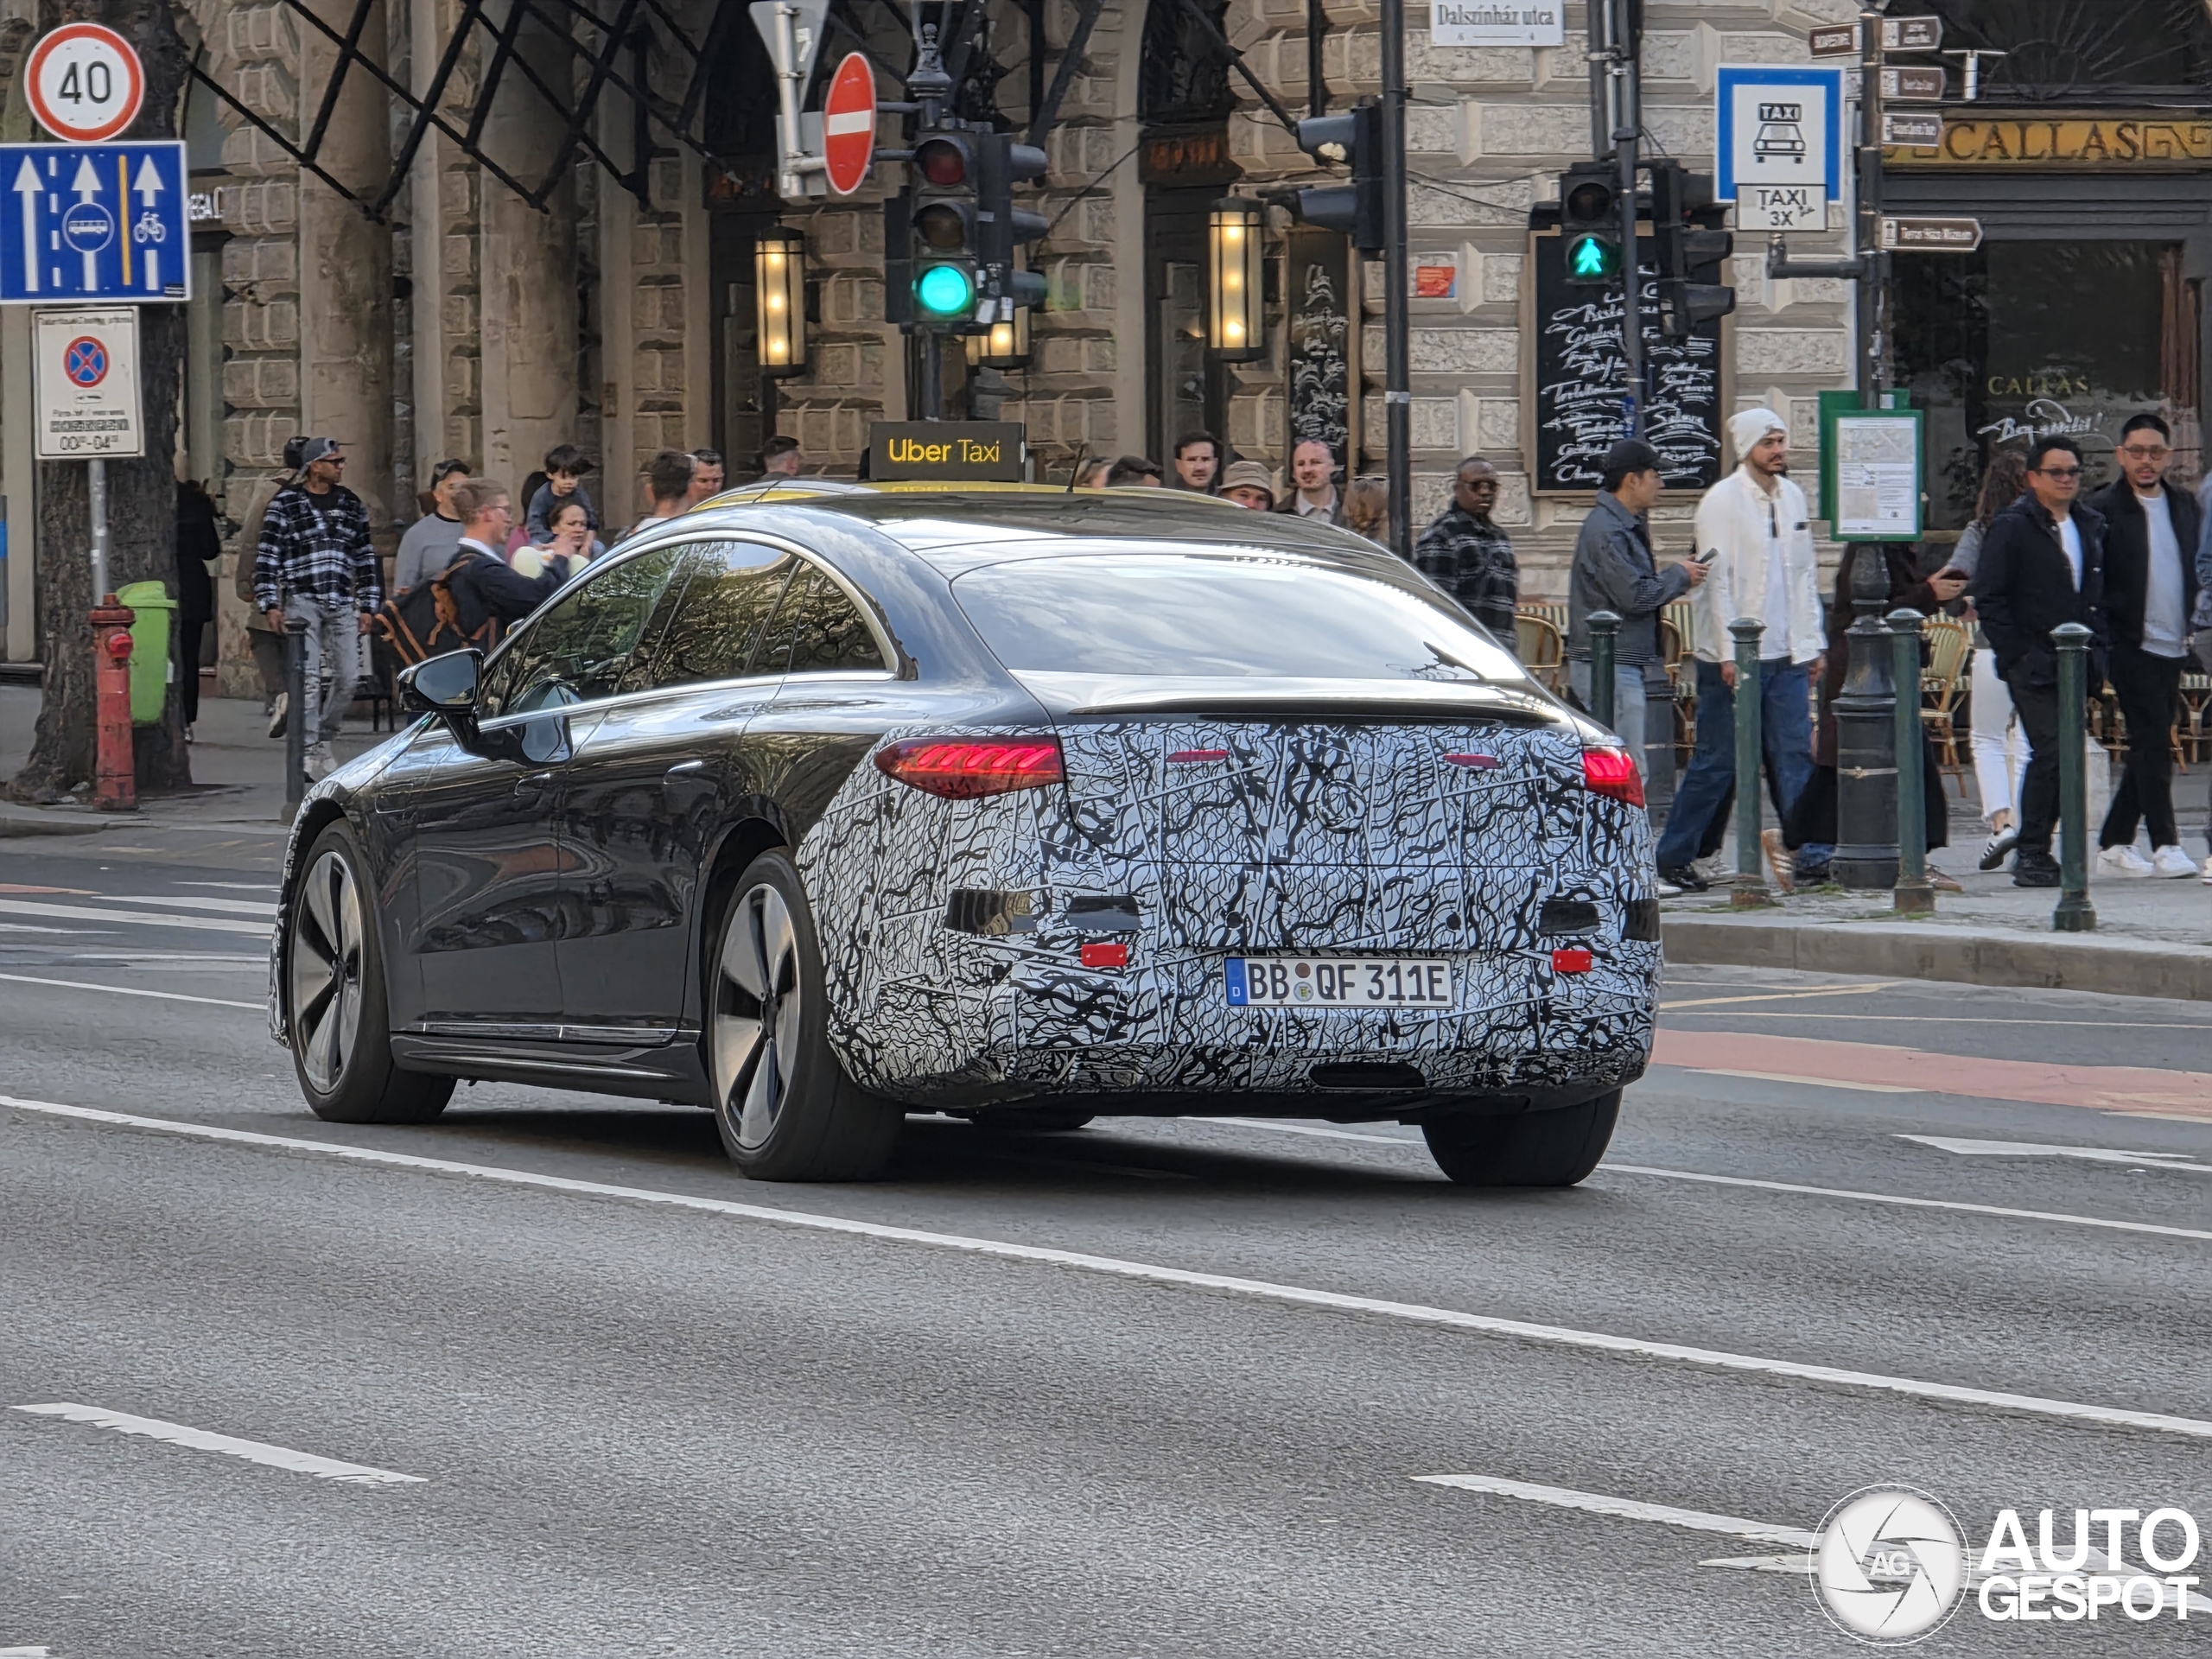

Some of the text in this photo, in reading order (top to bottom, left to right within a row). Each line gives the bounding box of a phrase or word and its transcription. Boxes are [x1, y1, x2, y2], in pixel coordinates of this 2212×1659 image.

[1522, 5, 1554, 25] utca
[58, 60, 111, 105] 40
[1761, 105, 1801, 120] TAXI
[1946, 122, 2140, 161] CALLAS
[1757, 189, 1807, 206] TAXI
[1770, 211, 1793, 226] 3X
[1988, 376, 2088, 396] CALLAS
[889, 439, 1000, 462] Uber Taxi
[1232, 963, 1447, 1001] D BB QF 311E
